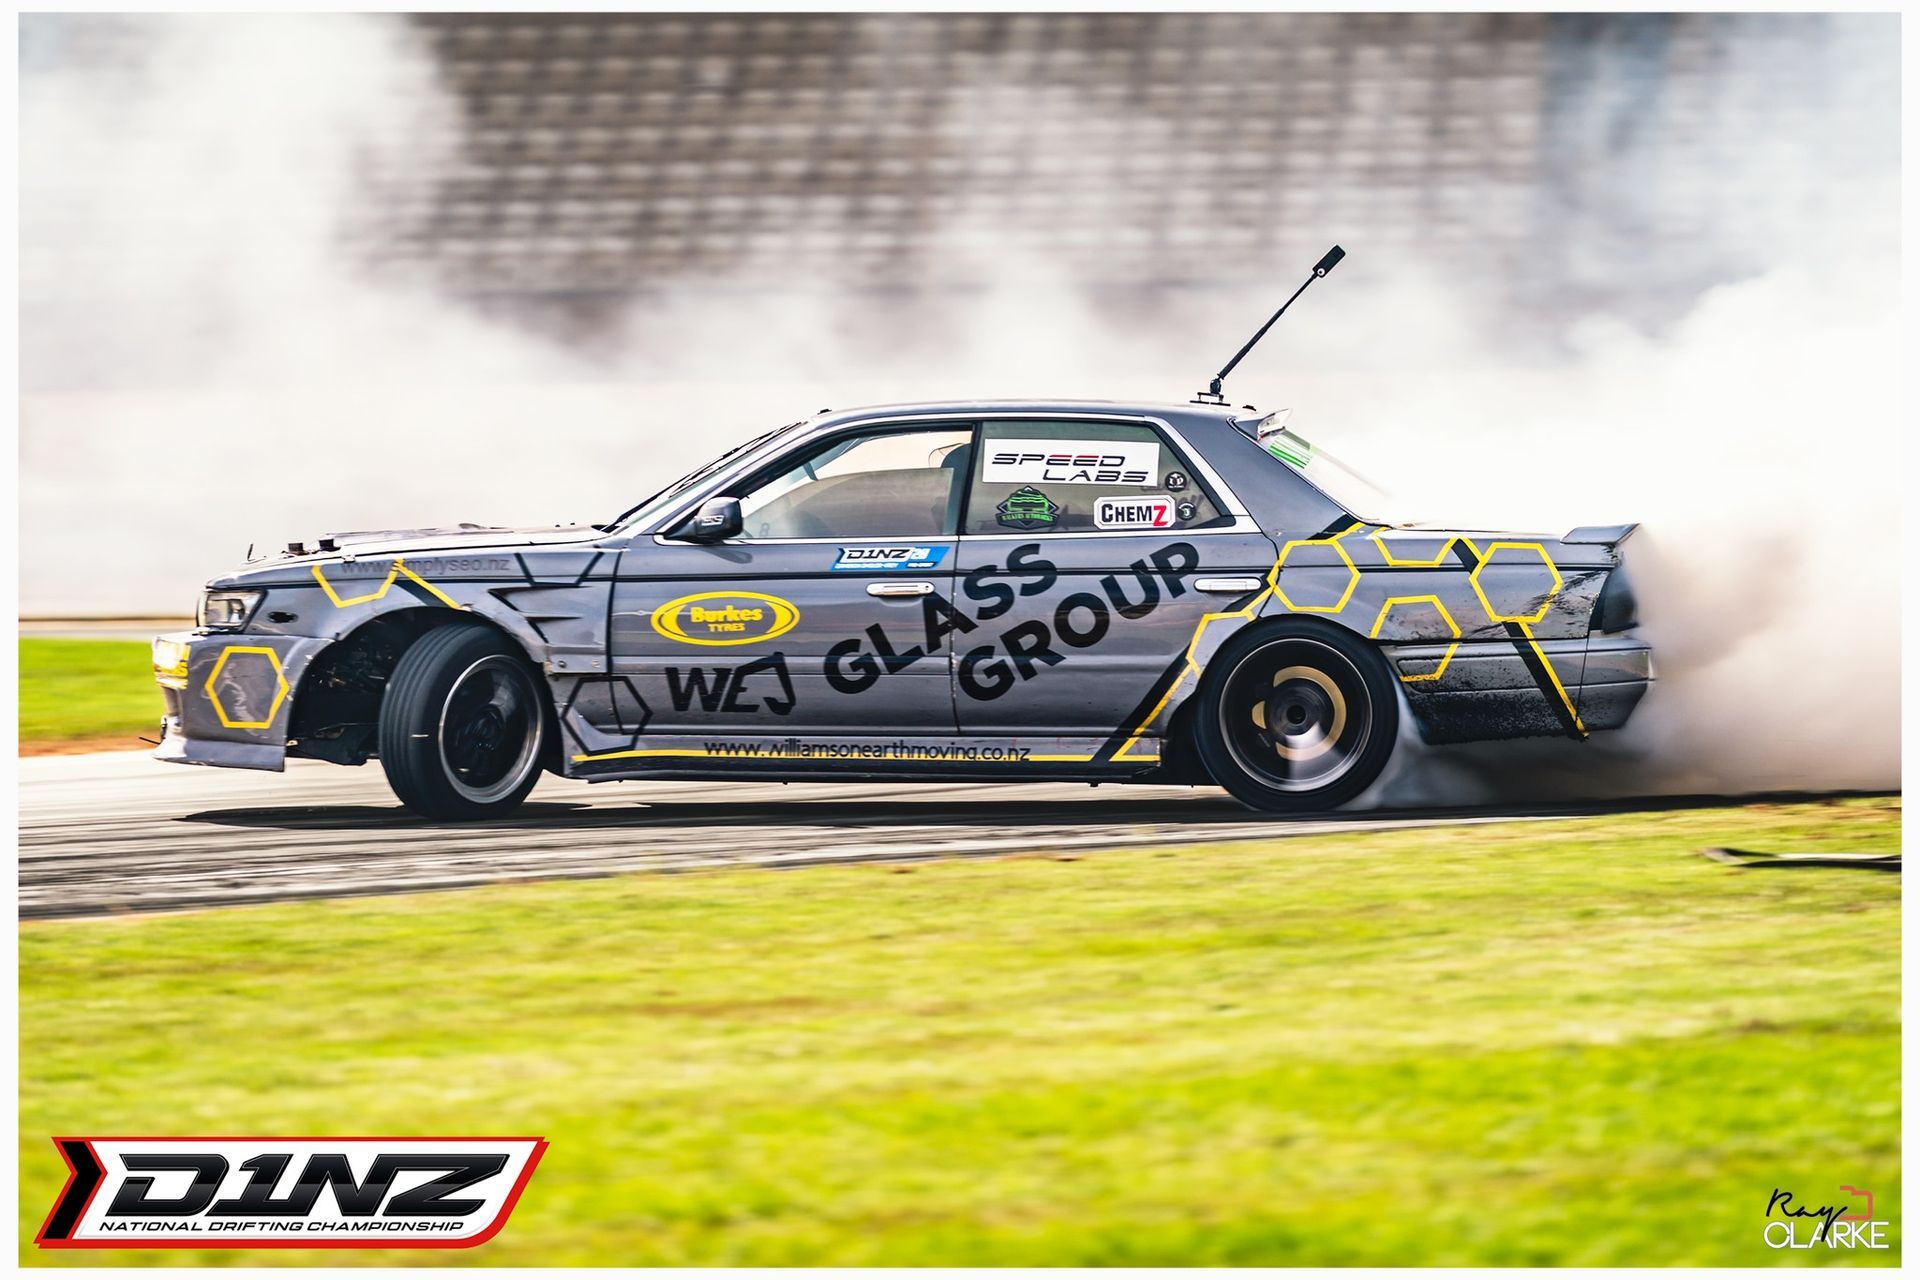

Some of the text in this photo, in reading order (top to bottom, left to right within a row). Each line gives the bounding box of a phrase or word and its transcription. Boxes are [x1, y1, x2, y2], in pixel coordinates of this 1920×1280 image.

[991, 453, 1126, 467] SPEED
[1042, 469, 1149, 482] LABS
[1101, 503, 1168, 527] CHEMZ
[846, 549, 910, 559] D1NZ
[690, 605, 763, 623] Burkes
[824, 543, 1058, 694] GLASS
[957, 541, 1199, 701] GROUP
[708, 623, 746, 632] TYRES
[664, 651, 797, 716] WEJ
